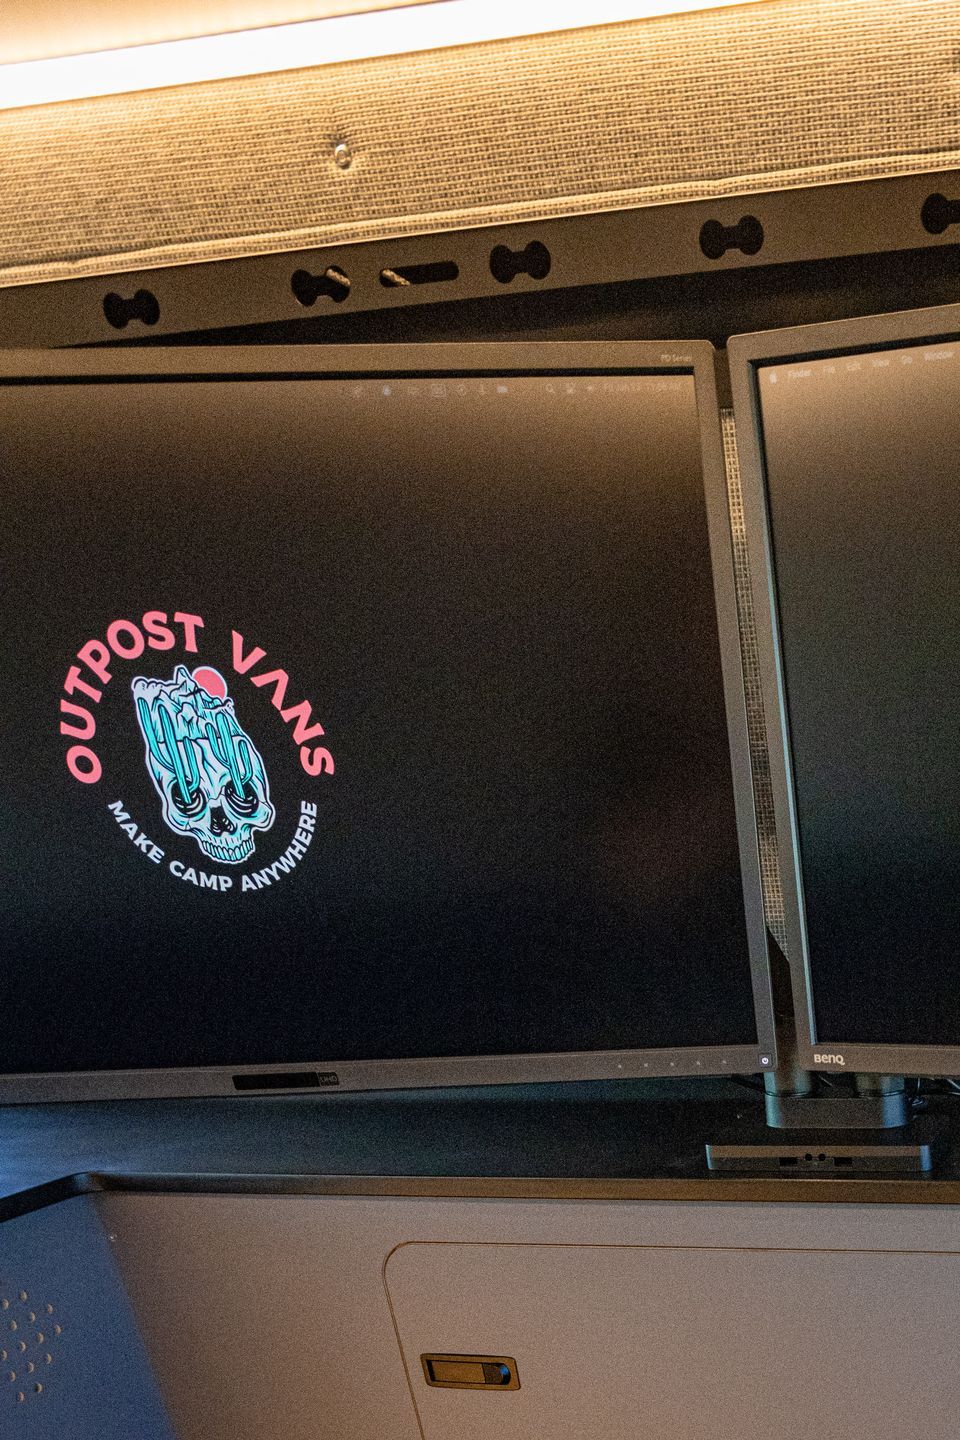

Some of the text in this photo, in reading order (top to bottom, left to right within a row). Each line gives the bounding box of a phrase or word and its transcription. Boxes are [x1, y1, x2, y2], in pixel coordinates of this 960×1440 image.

[60, 611, 334, 784] OUTPOST VANS
[107, 800, 318, 892] MAKE CAMP ANYWHERE
[813, 1053, 845, 1066] BenQ
